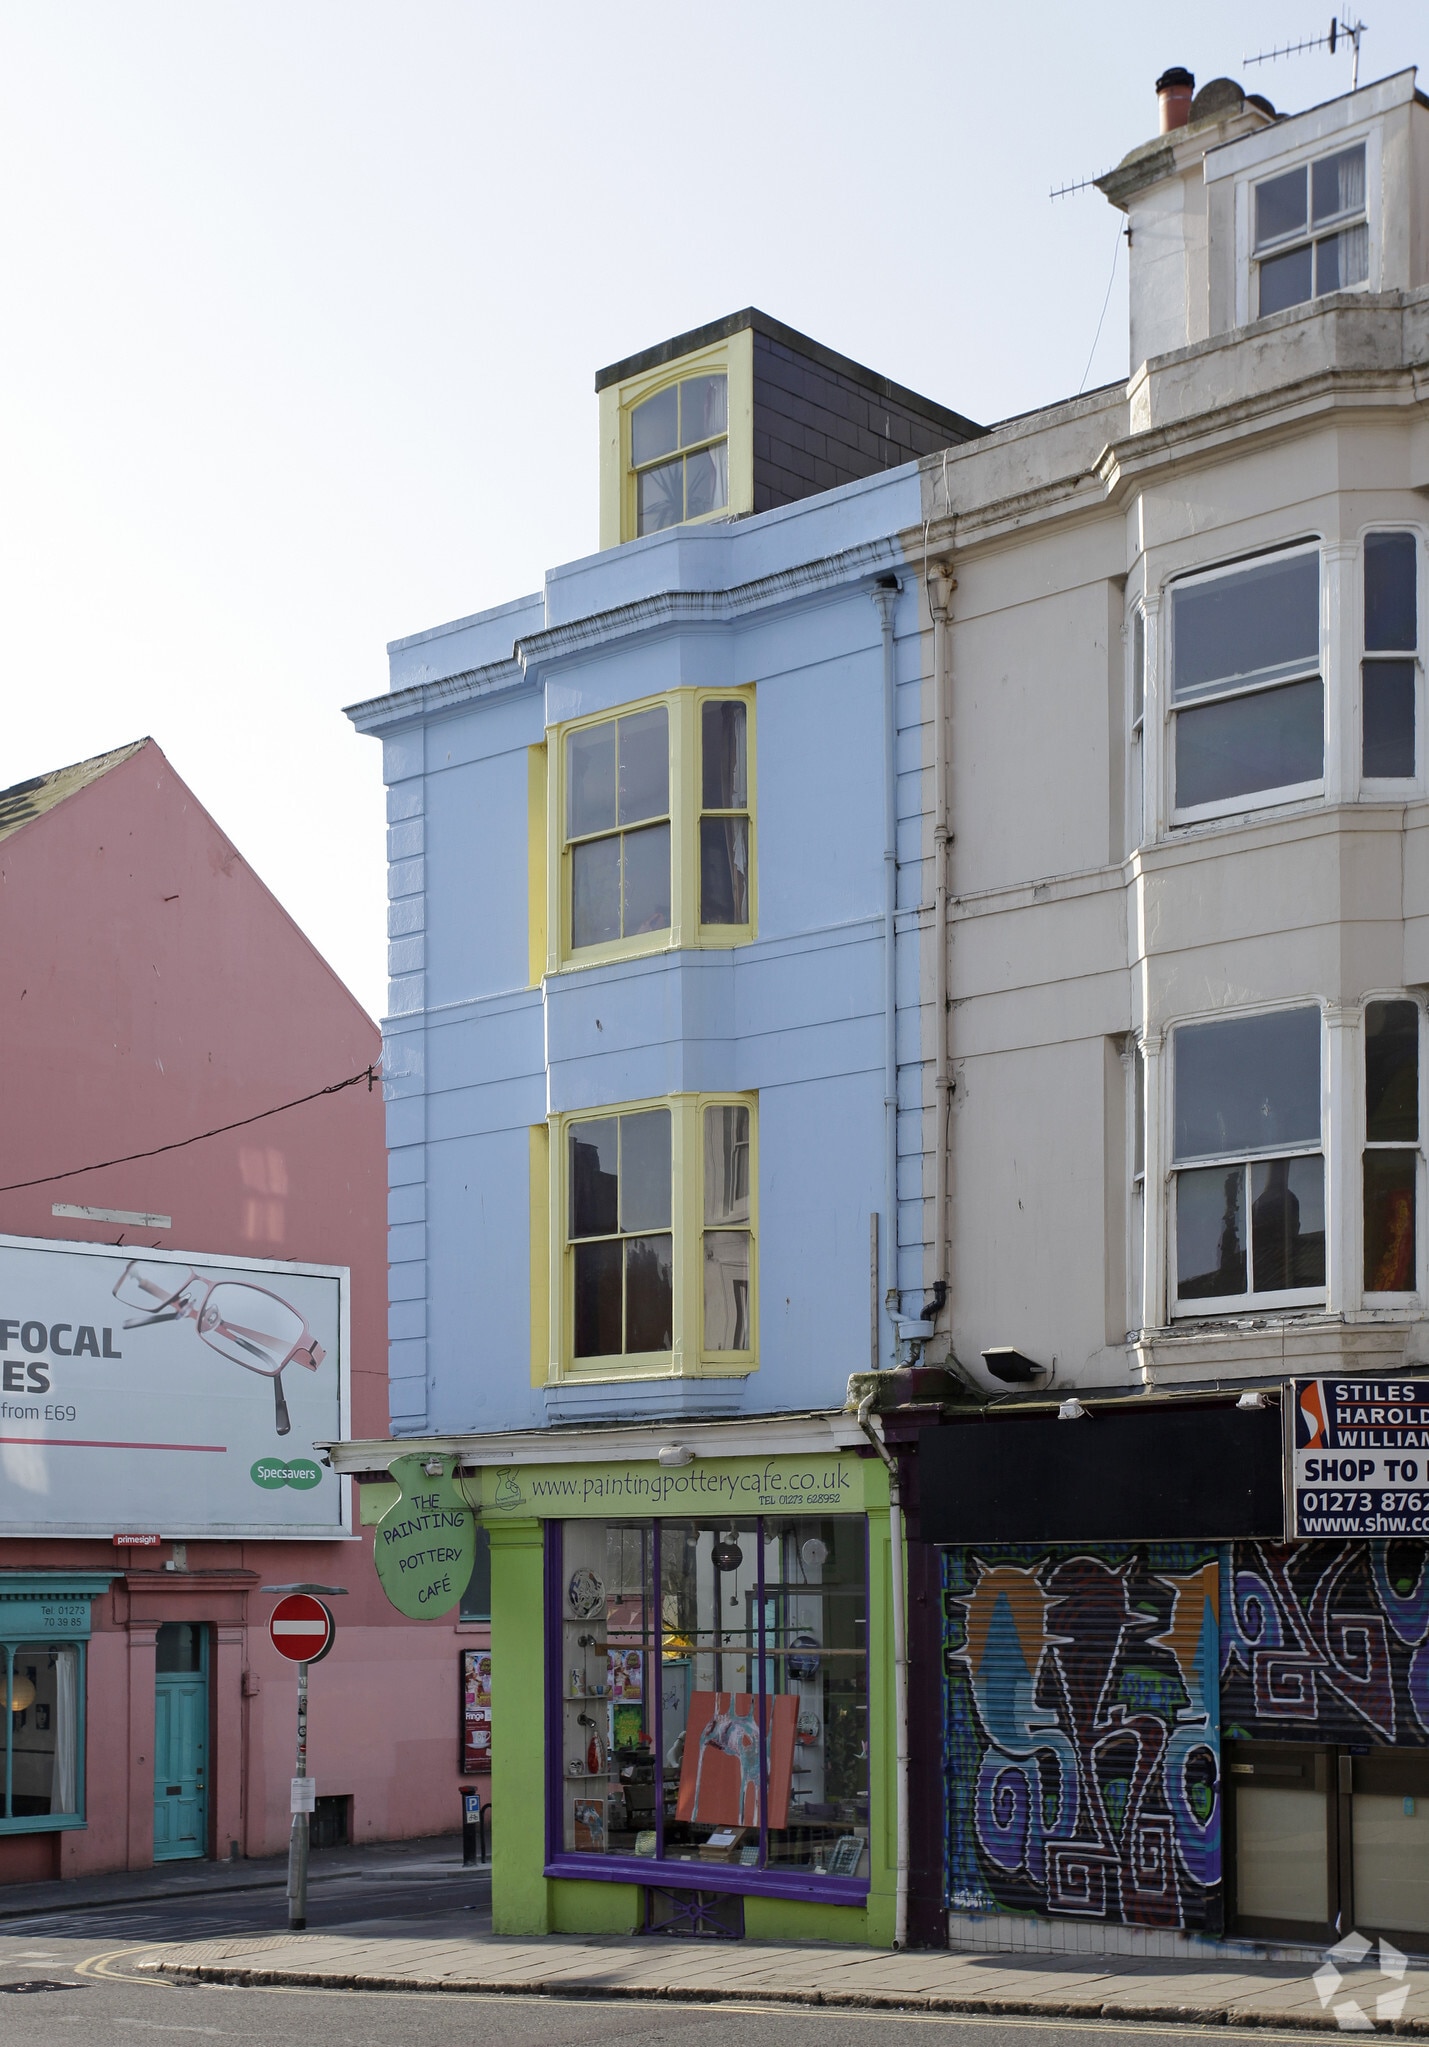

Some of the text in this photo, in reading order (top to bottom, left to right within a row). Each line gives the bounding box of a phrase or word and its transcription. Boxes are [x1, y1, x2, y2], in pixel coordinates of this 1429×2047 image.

[0, 1318, 122, 1359] FOCAL
[3, 1360, 50, 1394] ES
[1335, 1384, 1416, 1401] STILES
[1, 1402, 76, 1421] from £69
[1336, 1408, 1429, 1424] HAROLD
[257, 1465, 316, 1481] Specsavers
[1305, 1459, 1375, 1482] SHOP
[1384, 1459, 1418, 1482] TO
[532, 1461, 850, 1502] www.paintingpotterycafe.co.uk
[411, 1493, 440, 1509] THE
[758, 1493, 840, 1505] TEL 01273 628952
[1303, 1493, 1373, 1512] 01273
[383, 1512, 465, 1545] PAINTING
[117, 1535, 156, 1545] primesight
[399, 1548, 463, 1573] POTTERY
[418, 1573, 451, 1603] CAFÉ
[58, 1606, 85, 1615] 01273
[44, 1618, 82, 1626] 70 39 85
[469, 1798, 477, 1811] P
